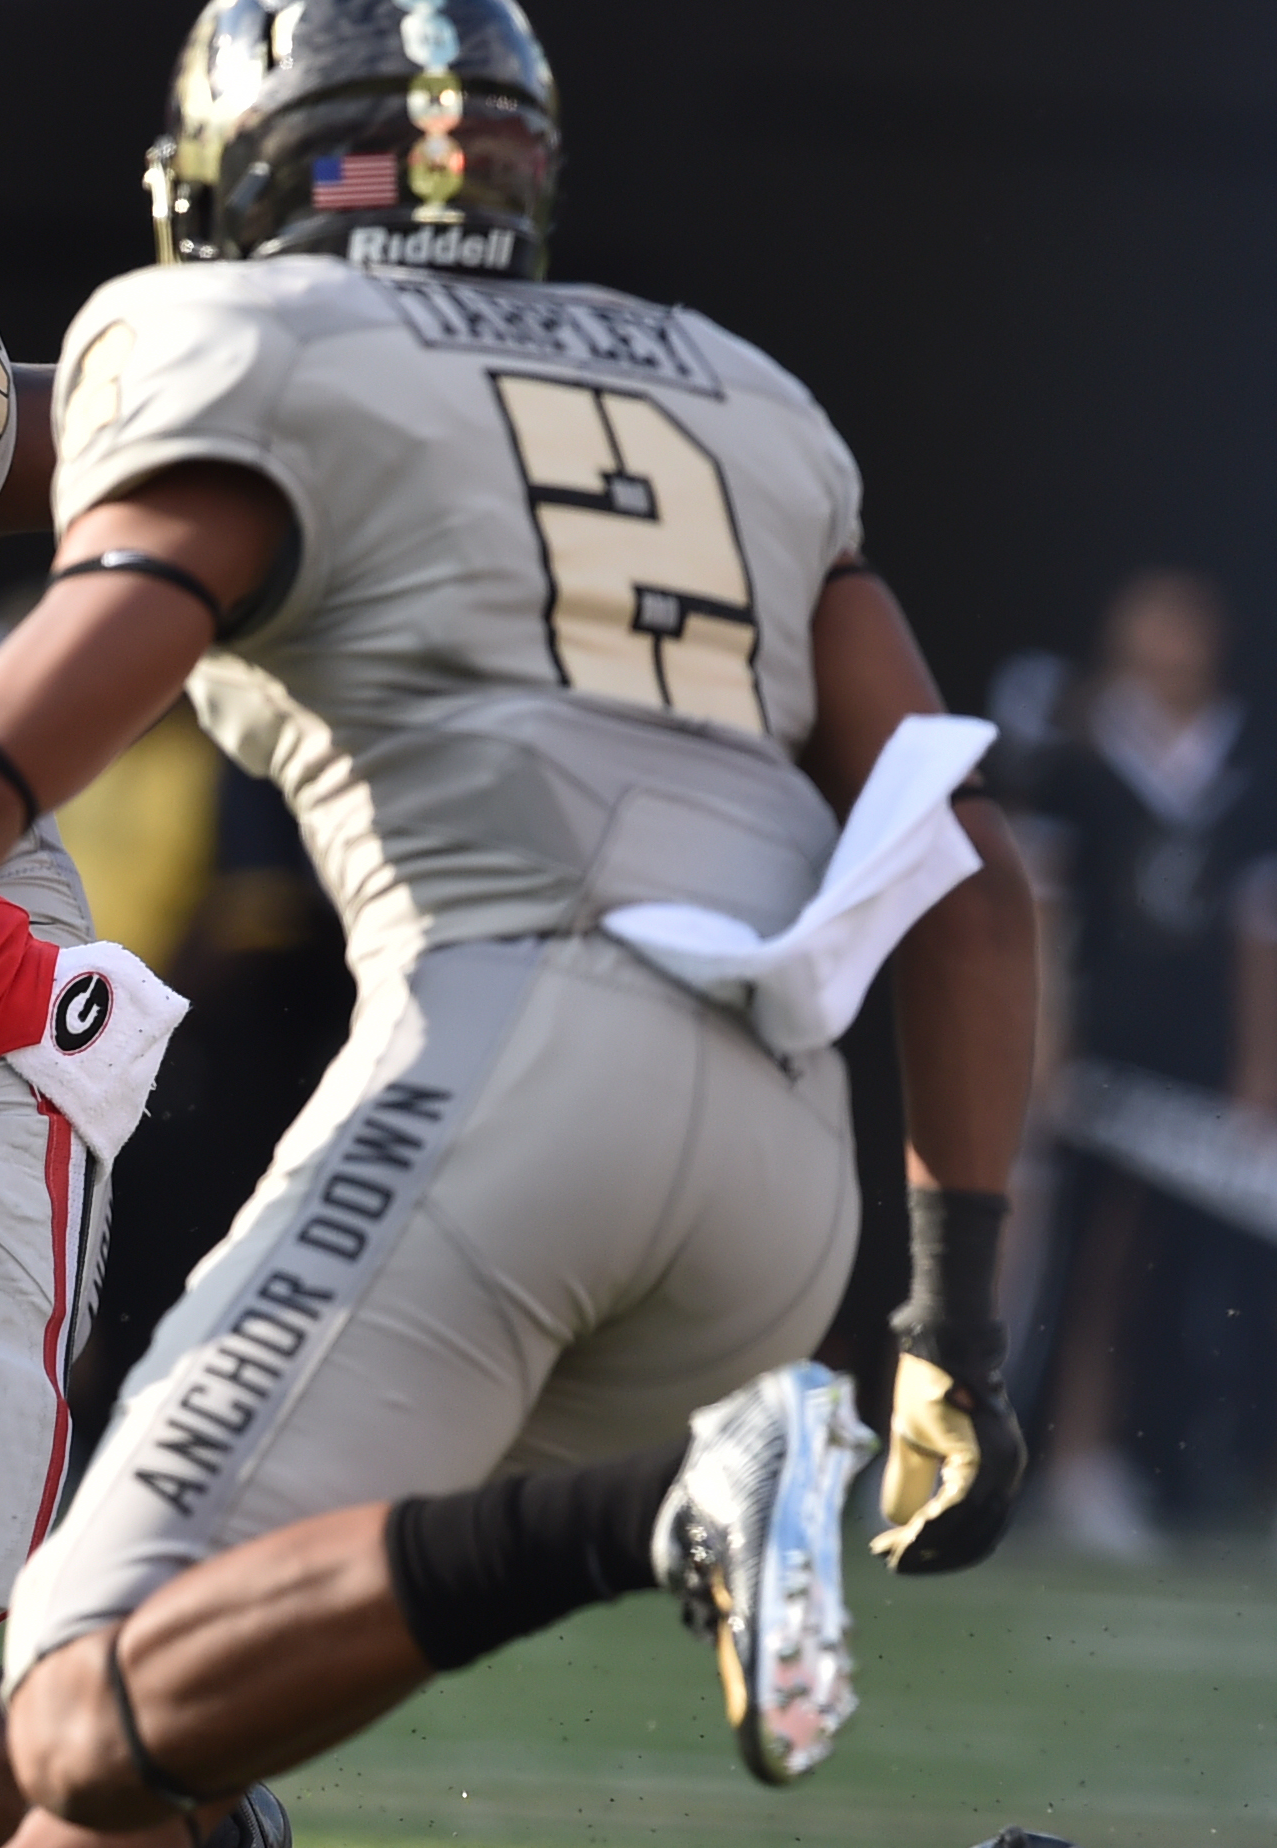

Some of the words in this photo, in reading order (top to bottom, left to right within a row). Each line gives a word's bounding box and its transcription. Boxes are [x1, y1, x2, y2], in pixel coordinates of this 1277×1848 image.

[346, 225, 517, 271] Riddell
[485, 368, 770, 737] 2
[134, 1270, 335, 1519] ANCHOR
[296, 1081, 455, 1263] DOWN
